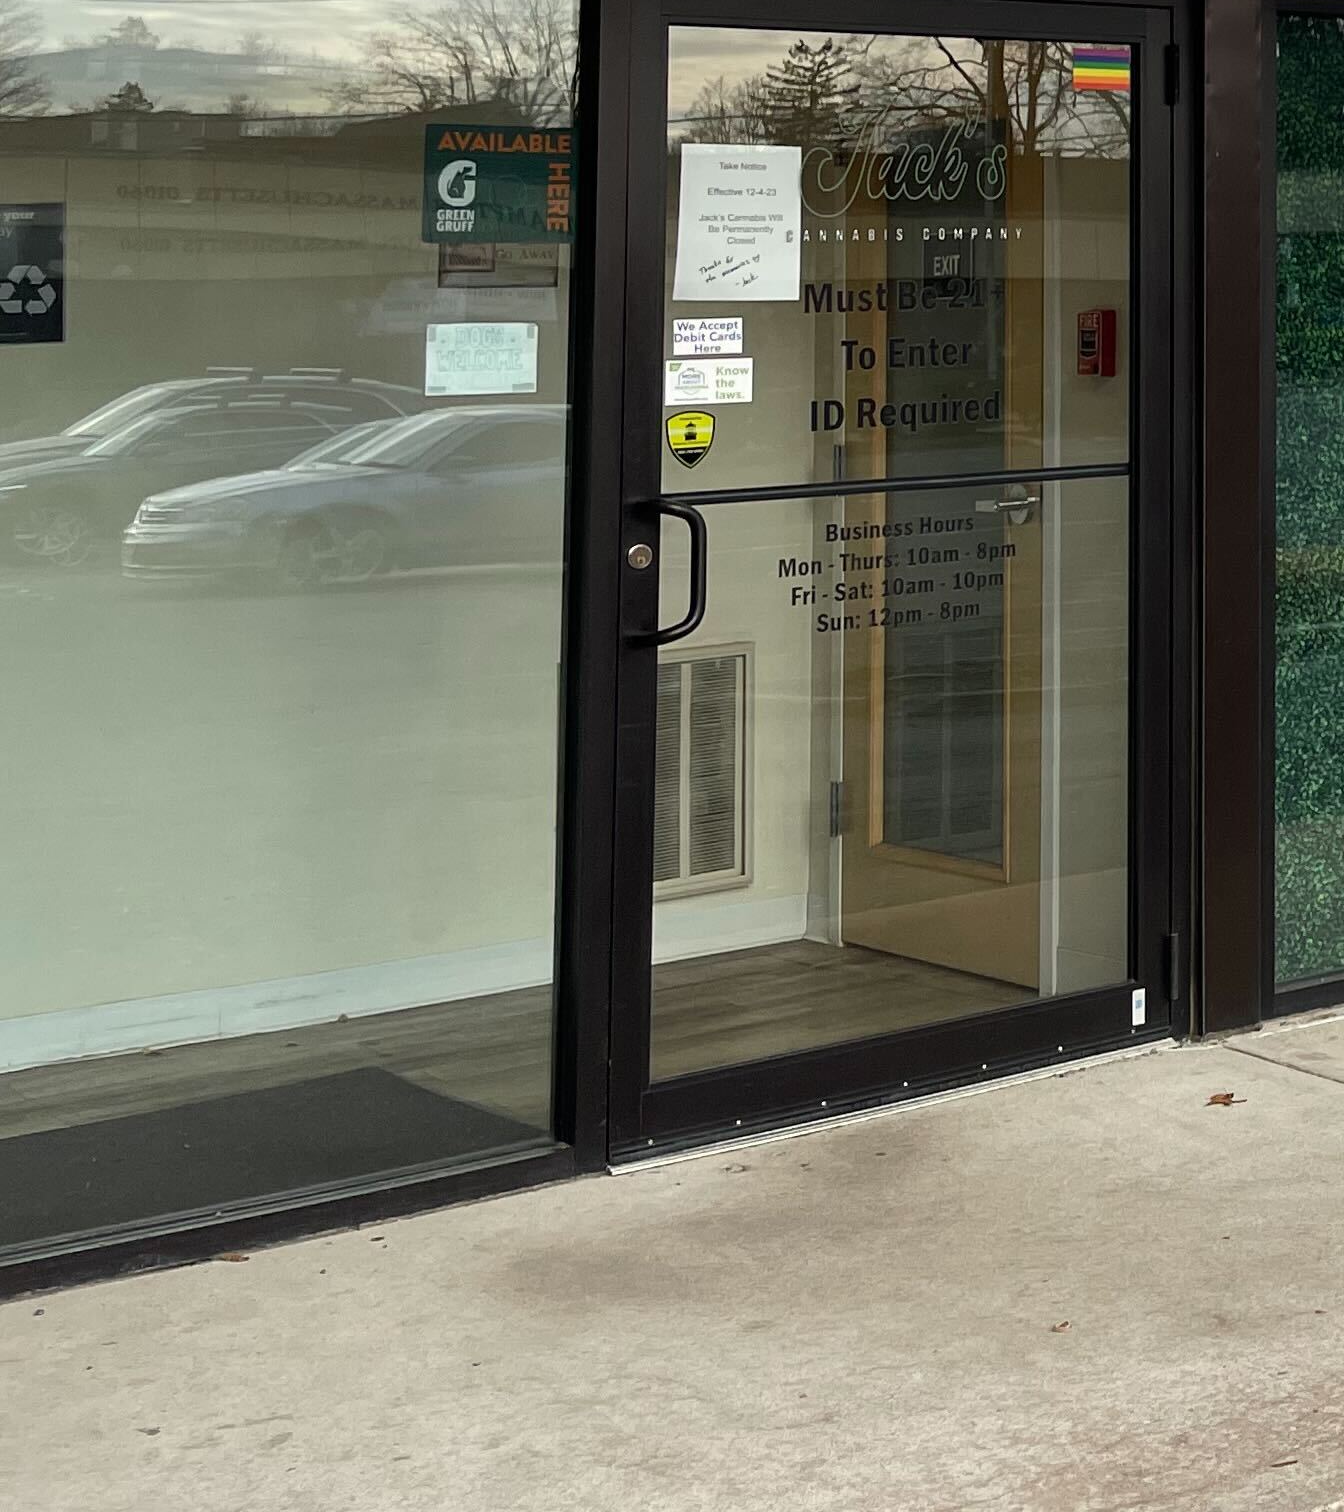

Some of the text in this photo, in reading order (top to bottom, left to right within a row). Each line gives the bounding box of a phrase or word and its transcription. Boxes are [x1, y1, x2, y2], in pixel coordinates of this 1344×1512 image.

[437, 131, 571, 154] AVAILABLE
[719, 162, 767, 171] Take Notice
[800, 104, 1008, 218] Jack's
[547, 163, 571, 232] HERE
[708, 187, 743, 196] Effective
[436, 209, 475, 221] GREEN
[698, 214, 725, 223] Jack's
[728, 214, 766, 222] Cannabis
[436, 220, 474, 233] GRUFF
[708, 225, 774, 234] Be Permanently
[726, 237, 756, 245] Closed
[786, 227, 1023, 243] CANNABIS COMPANY
[933, 254, 961, 277] EXIT
[803, 281, 889, 314] Must
[897, 279, 938, 311] Be
[676, 320, 739, 333] We Accept
[674, 331, 742, 344] Debit Cards
[694, 344, 722, 353] Here
[841, 338, 973, 371] To Enter
[715, 366, 750, 376] Know
[715, 378, 736, 389] the
[715, 390, 745, 400] laws.
[810, 390, 1000, 432] ID Required
[825, 516, 975, 543] Business Hours
[778, 558, 823, 579] Mon
[839, 552, 900, 573] Thurs:
[906, 546, 960, 566] 10am
[976, 541, 1017, 562] 8pm
[791, 586, 816, 606] Fri
[834, 582, 874, 602] Sat:
[881, 577, 934, 597] 10am
[952, 570, 1005, 592] 10pm
[816, 613, 861, 633] Sun:
[868, 607, 922, 628] 12pm
[939, 601, 980, 622] 8pm
